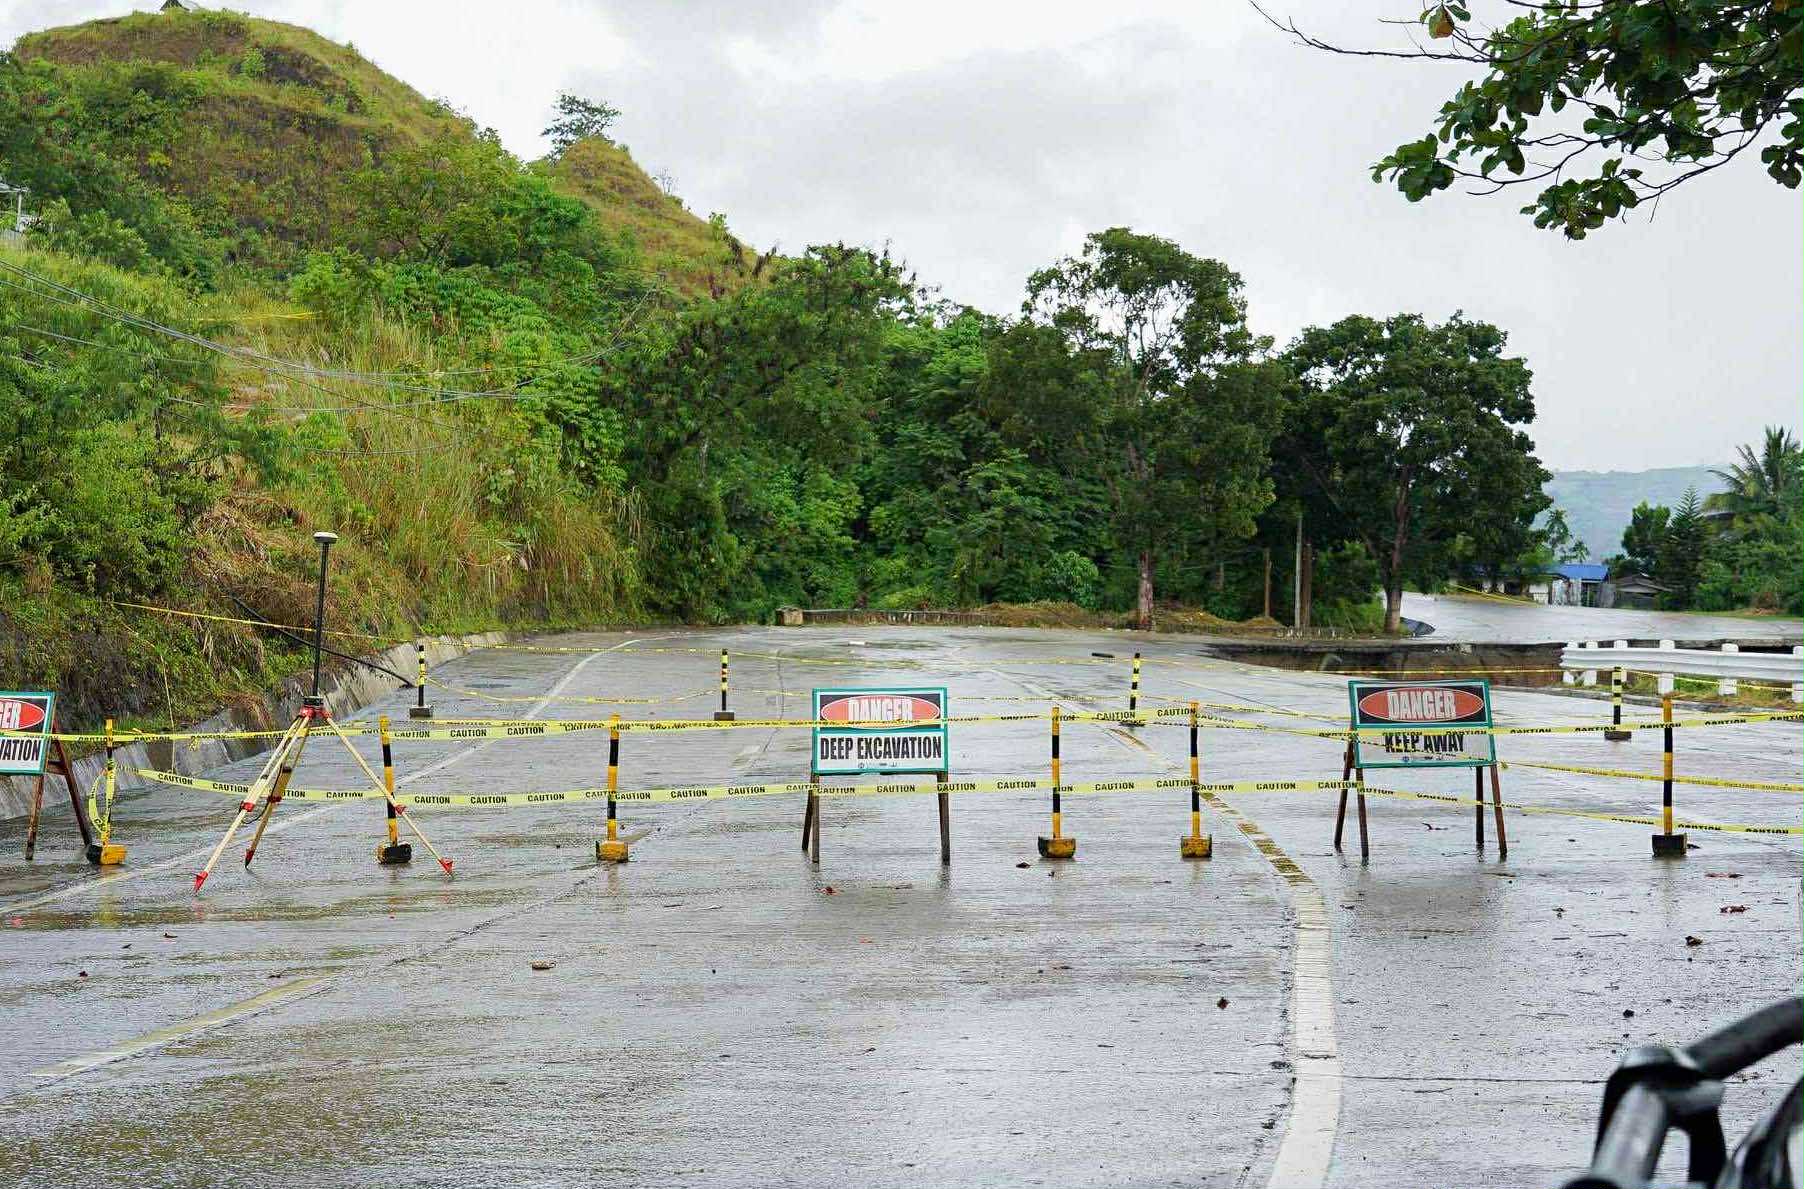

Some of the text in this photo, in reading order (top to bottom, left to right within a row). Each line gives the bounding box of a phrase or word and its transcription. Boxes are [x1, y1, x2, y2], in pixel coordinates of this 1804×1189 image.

[848, 698, 913, 721] DANGER
[1387, 691, 1456, 721] DANGER
[1096, 711, 1136, 721] CAUTION
[1157, 708, 1196, 717] CAUTION
[450, 729, 487, 738] CAUTION
[507, 726, 544, 736] CAUTION
[820, 736, 942, 760] DEEP EXCAVATION
[1385, 734, 1464, 753] KEEP AWAY
[158, 773, 194, 785] CAUTION
[212, 782, 249, 793] CAUTION
[876, 784, 915, 793] CAUTION
[937, 783, 976, 792] CAUTION
[997, 781, 1037, 790] CAUTION
[1095, 782, 1135, 791] CAUTION
[1156, 779, 1196, 788] CAUTION
[1256, 782, 1296, 790] CAUTION
[1318, 781, 1358, 789] CAUTION
[414, 795, 450, 804] CAUTION
[470, 796, 507, 804] CAUTION
[527, 793, 565, 802] CAUTION
[615, 792, 651, 800] CAUTION
[670, 789, 708, 798] CAUTION
[728, 786, 766, 795] CAUTION
